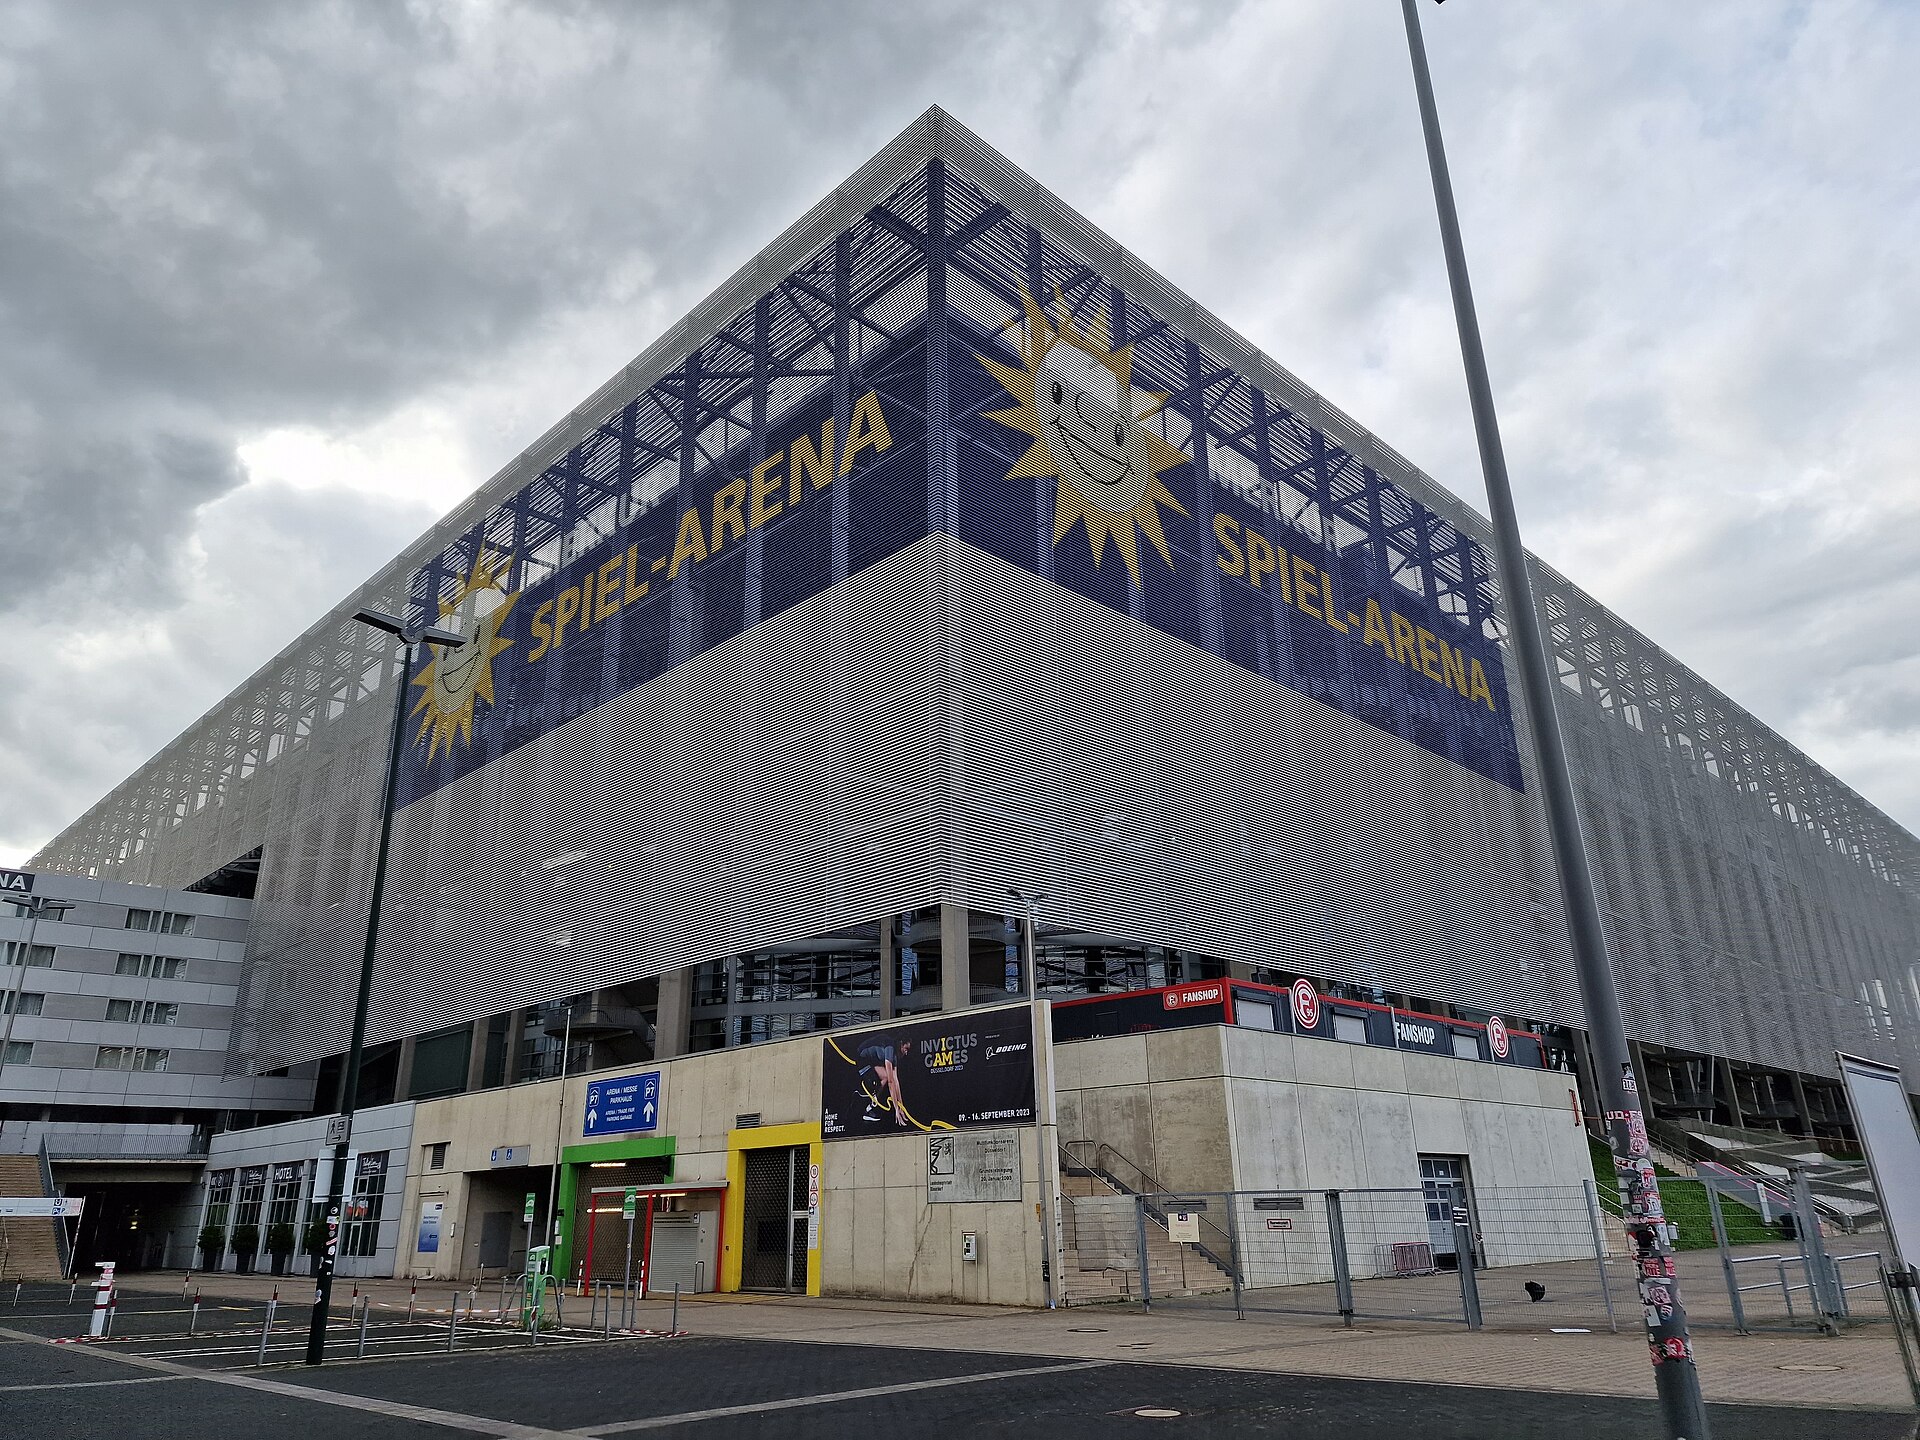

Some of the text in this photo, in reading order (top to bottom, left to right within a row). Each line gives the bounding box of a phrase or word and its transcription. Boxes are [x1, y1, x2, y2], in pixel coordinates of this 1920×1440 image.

[528, 390, 893, 664] SPIEL-ARENA
[1212, 513, 1496, 712] SPIEL-ARENA
[1182, 989, 1219, 1003] FANSHOP
[1395, 1021, 1435, 1046] FANSHOP
[920, 1033, 978, 1054] INVICTUS
[995, 1043, 1027, 1053] BOEING
[924, 1049, 969, 1068] GAMES
[606, 1087, 620, 1095] ARENA
[623, 1085, 638, 1093] MESSE
[645, 1087, 655, 1097] P7
[589, 1095, 598, 1105] P7
[981, 1109, 1015, 1119] SEPTEMBER
[1016, 1108, 1030, 1117] 2023
[825, 1125, 846, 1133] RESPECT.
[275, 1167, 293, 1180] HOTEL
